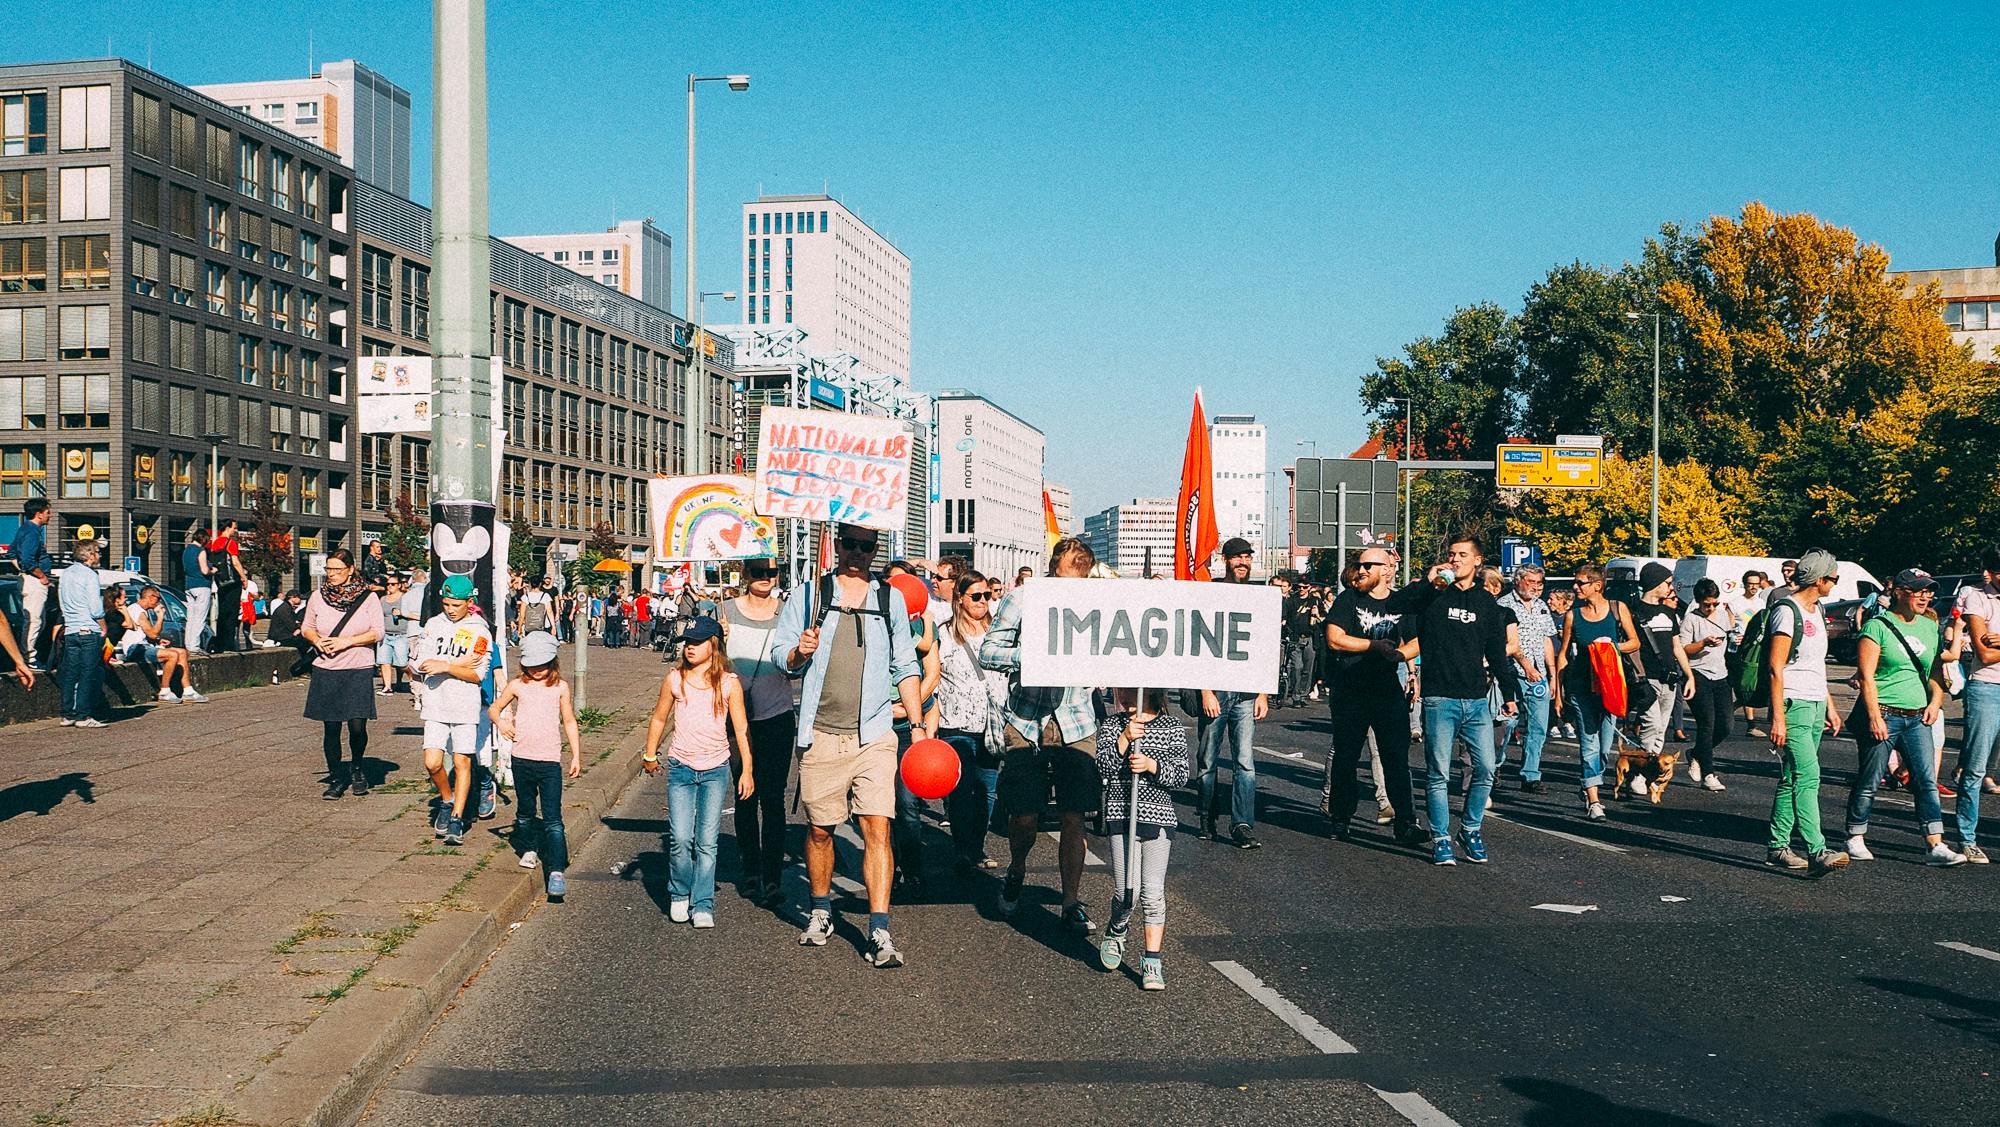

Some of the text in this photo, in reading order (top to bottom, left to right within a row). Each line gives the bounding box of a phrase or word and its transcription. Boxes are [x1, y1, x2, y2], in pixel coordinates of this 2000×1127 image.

[734, 392, 744, 450] RATHAUS
[964, 413, 973, 436] ONE
[827, 457, 887, 486] RAUS
[792, 475, 841, 498] DEN
[1514, 546, 1530, 565] P
[1047, 606, 1253, 661] IMAGINE
